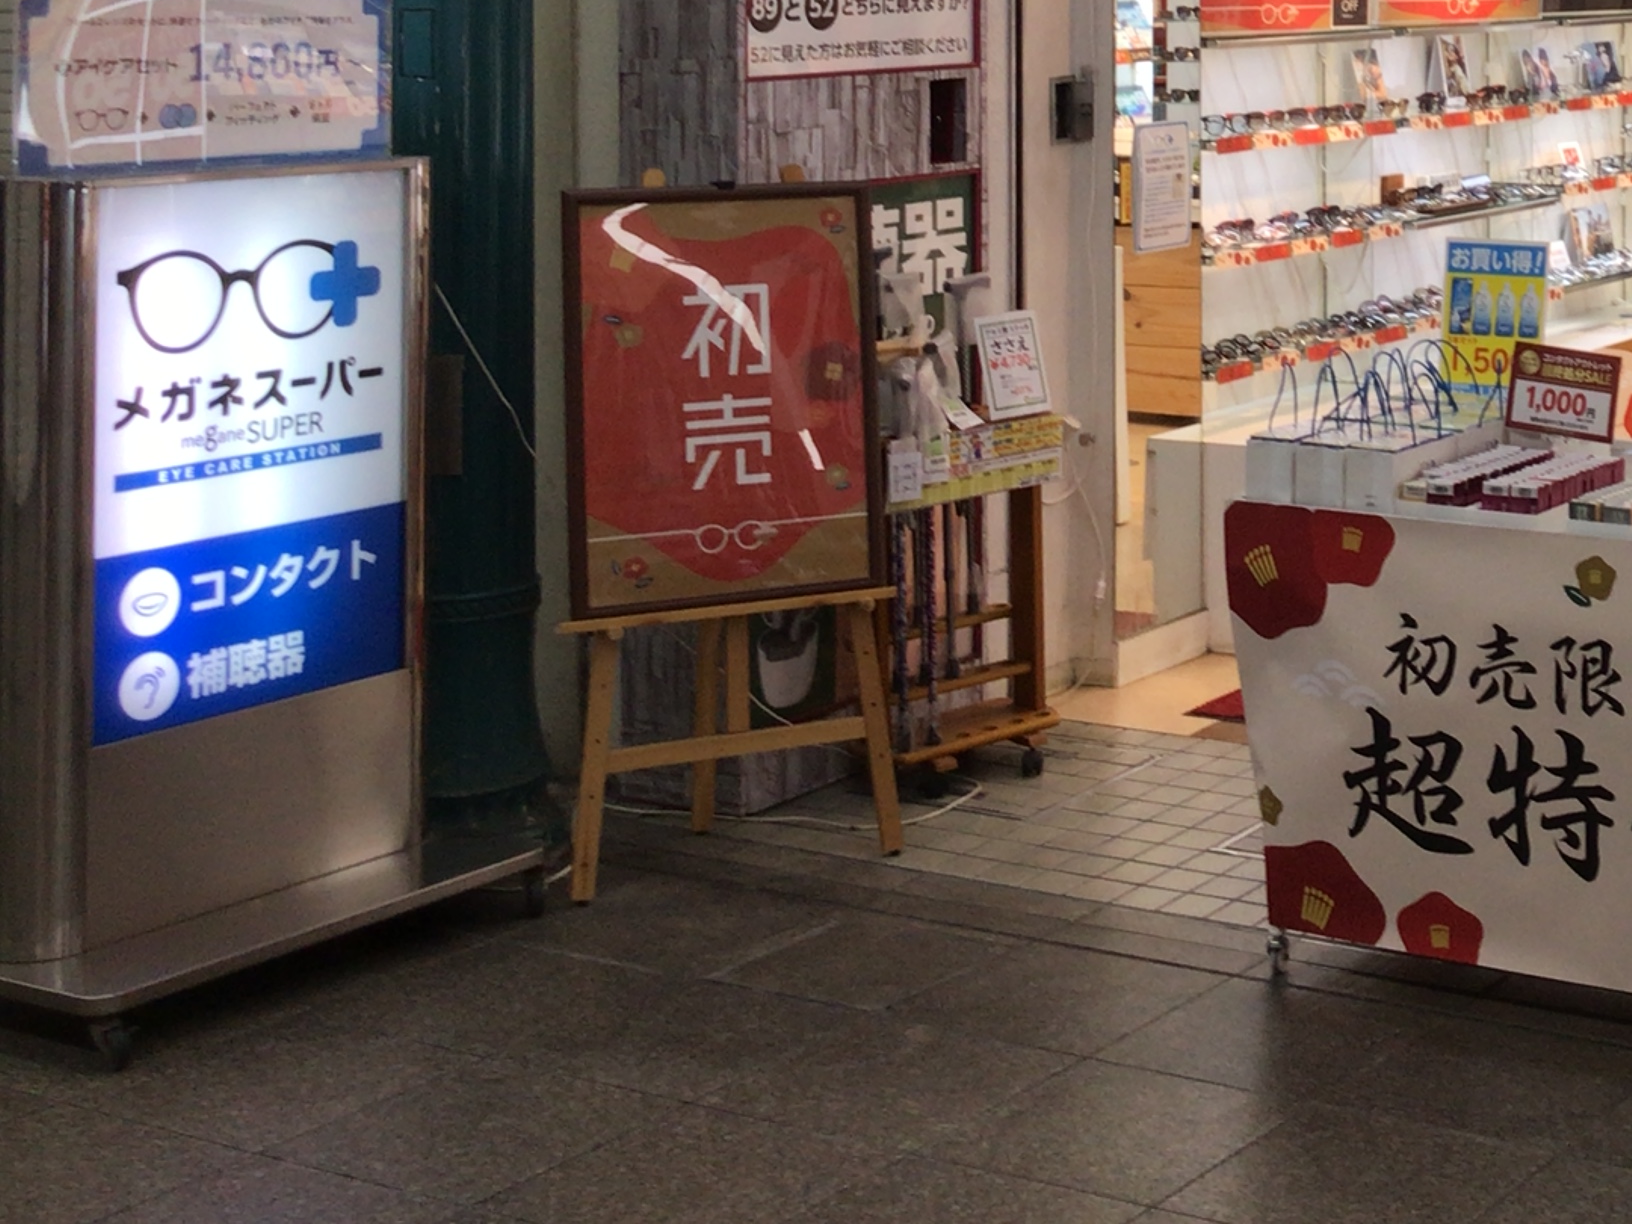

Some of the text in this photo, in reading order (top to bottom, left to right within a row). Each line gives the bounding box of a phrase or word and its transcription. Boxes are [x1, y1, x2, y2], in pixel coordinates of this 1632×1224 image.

[1451, 247, 1542, 274] お買い得!
[113, 356, 384, 432] メガネスーパー
[681, 282, 773, 491] 初売
[157, 441, 341, 484] EYE CARE STATION
[190, 539, 378, 613] コンタクト
[187, 630, 306, 701] 補聴器
